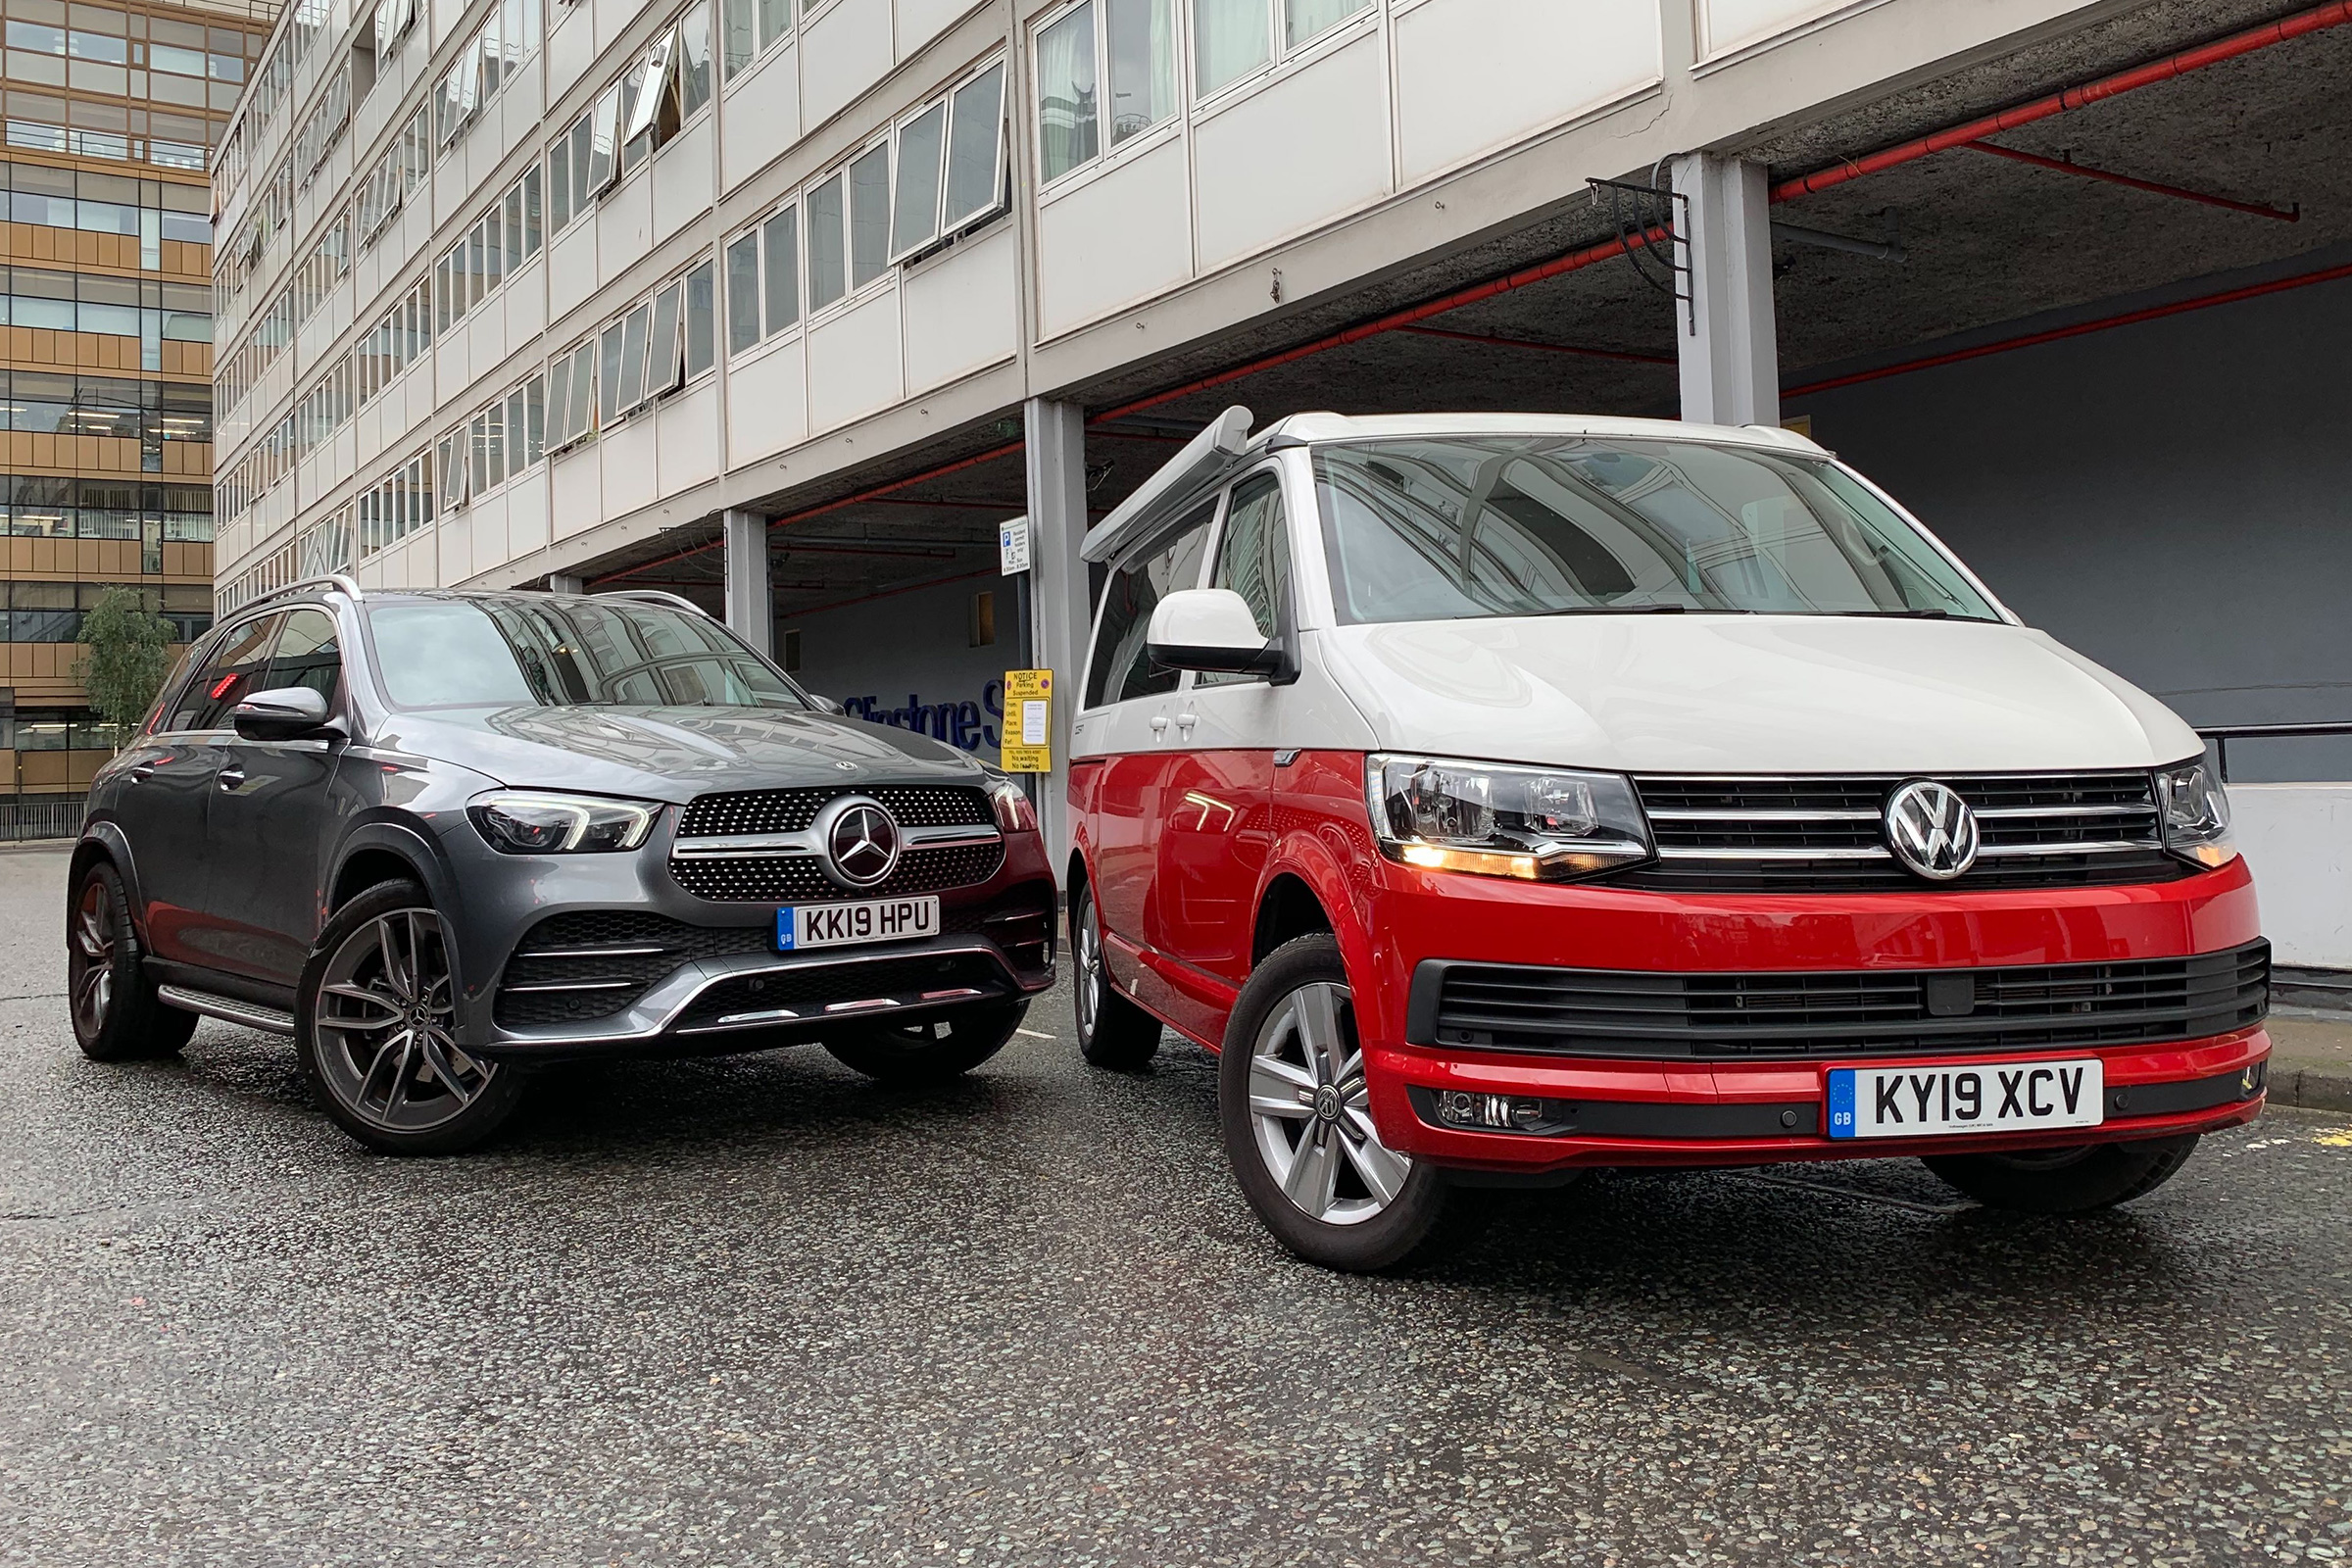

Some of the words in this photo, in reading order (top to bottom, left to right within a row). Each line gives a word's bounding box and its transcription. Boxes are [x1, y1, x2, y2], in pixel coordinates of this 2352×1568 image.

[1013, 671, 1038, 680] NOTICE
[807, 906, 871, 942] KK19
[880, 902, 929, 935] HPU
[780, 933, 792, 944] GB
[1876, 1072, 1983, 1125] KY19
[1998, 1066, 2084, 1119] XCV
[1834, 1111, 1851, 1126] GB
